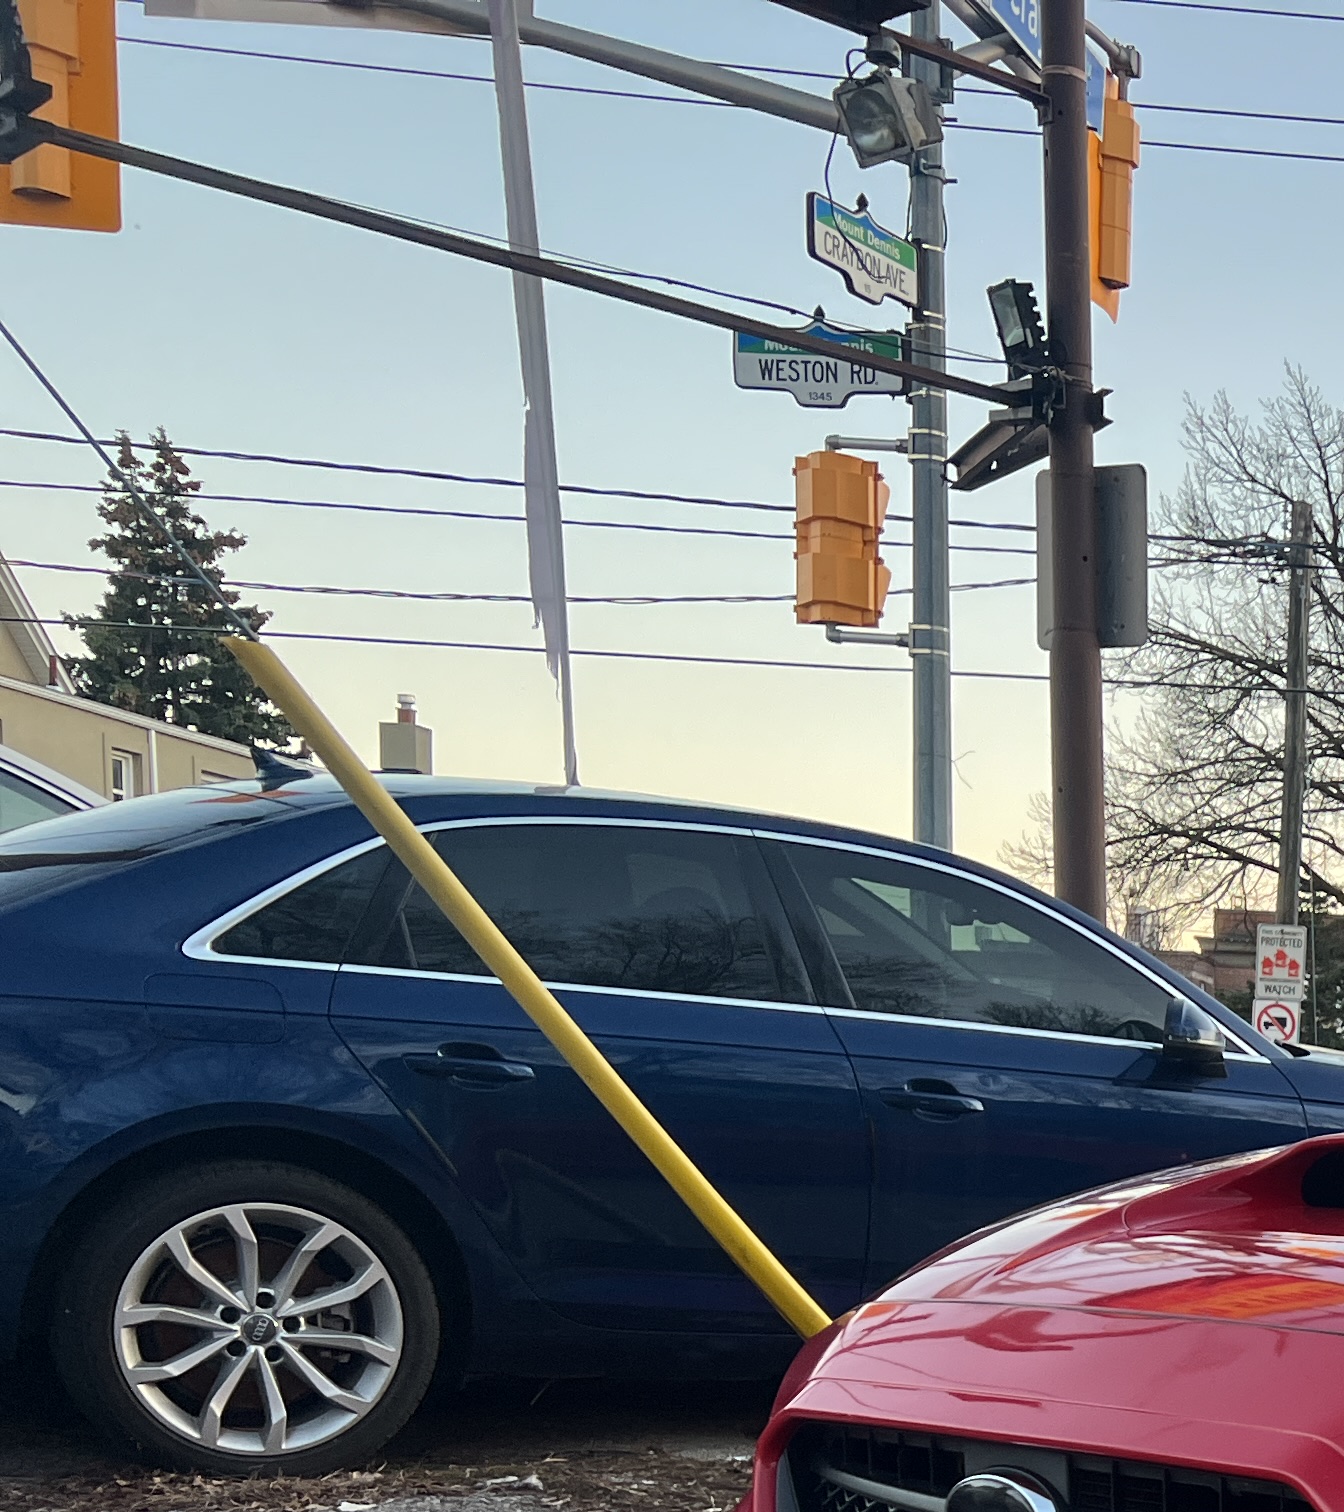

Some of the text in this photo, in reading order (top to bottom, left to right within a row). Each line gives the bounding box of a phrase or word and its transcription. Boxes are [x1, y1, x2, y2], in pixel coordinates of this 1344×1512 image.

[832, 211, 901, 260] Mount Dennis
[823, 231, 880, 277] CRAYDON
[758, 358, 838, 384] WESTON
[808, 391, 833, 402] 1345
[1260, 936, 1303, 949] PROTECTED
[1264, 984, 1296, 996] WATCH
